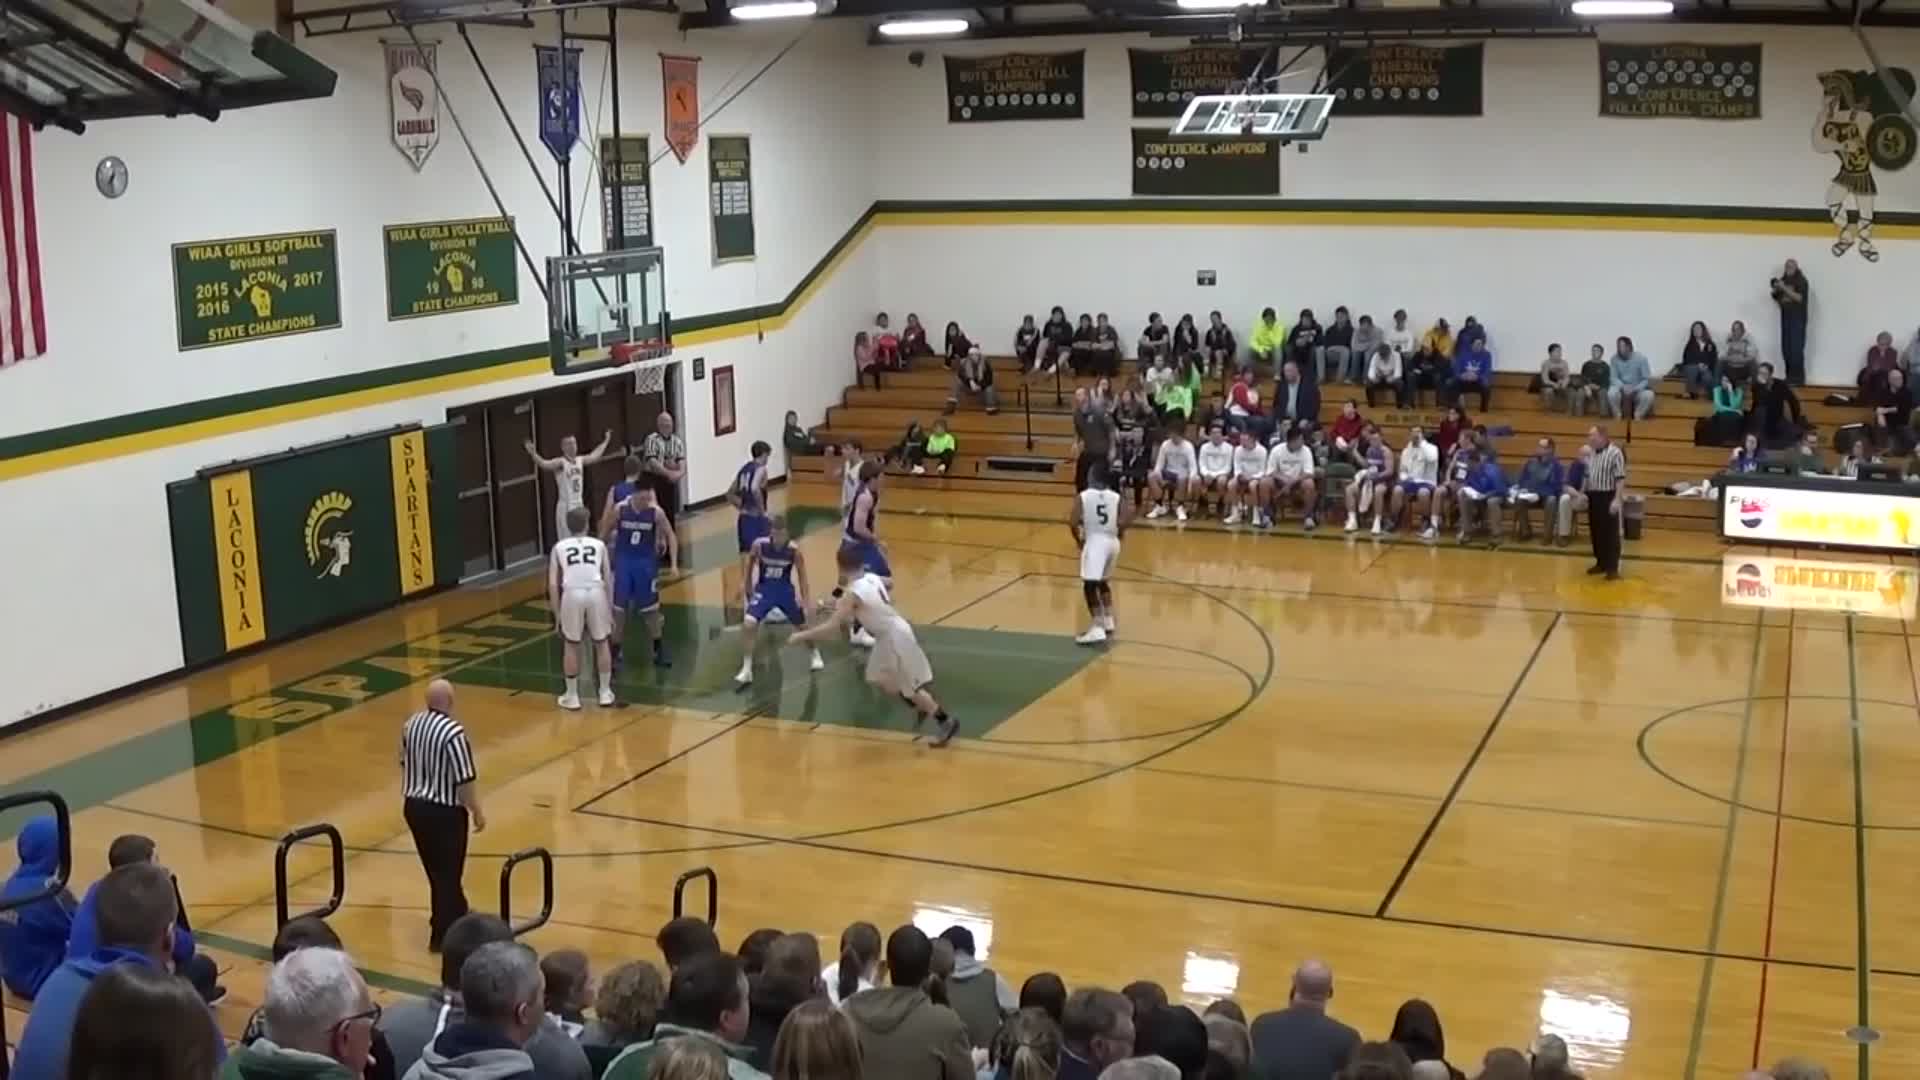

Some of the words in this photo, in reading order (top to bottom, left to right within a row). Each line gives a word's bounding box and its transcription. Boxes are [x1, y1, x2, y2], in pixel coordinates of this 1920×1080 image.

[388, 229, 418, 242] WIAA
[419, 226, 449, 240] GIRLS
[450, 221, 511, 237] VOLLEYBALL
[188, 245, 223, 262] WIAA
[224, 240, 262, 257] GIRLS
[264, 235, 324, 254] SOFTBALL
[229, 255, 277, 271] DIVISION
[433, 250, 476, 276] LACONIA
[233, 270, 288, 299] LACONIA
[293, 271, 324, 287] 2017
[195, 281, 229, 300] 2015
[196, 300, 230, 318] 2016
[412, 300, 442, 313] STATE
[443, 291, 499, 308] CHAMPIONS
[207, 323, 247, 342] STATE
[248, 313, 316, 336] CHAMPIONS
[402, 437, 425, 586] SPARTANS
[1096, 504, 1109, 526] 5
[225, 486, 253, 631] LACONIA
[565, 545, 597, 566] 22
